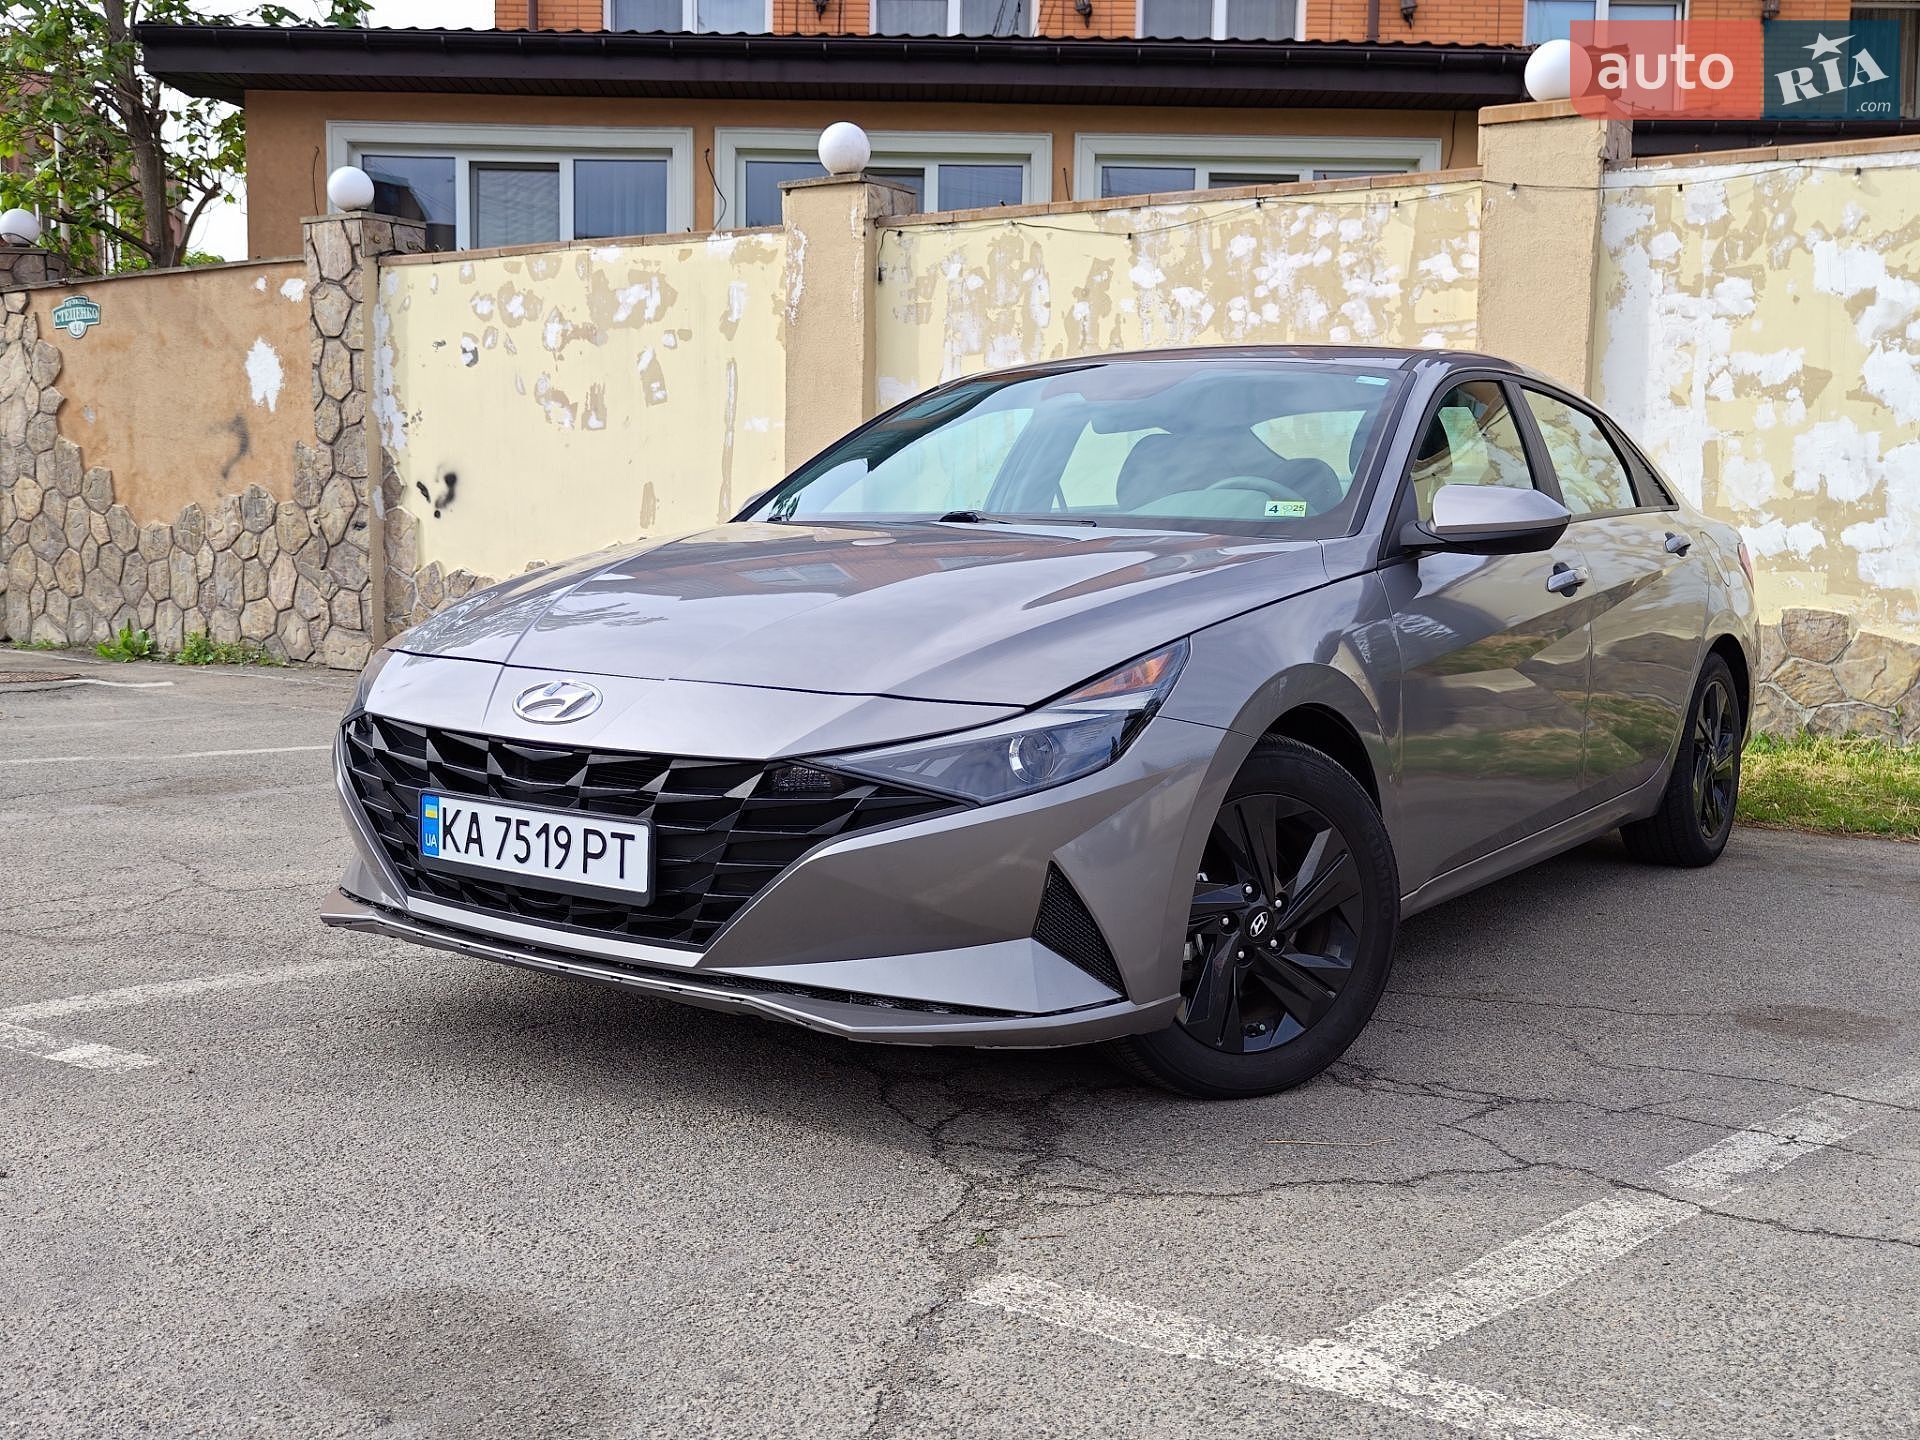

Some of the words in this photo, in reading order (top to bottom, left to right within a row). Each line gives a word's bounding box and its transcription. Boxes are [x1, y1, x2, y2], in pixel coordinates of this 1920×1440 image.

[55, 307, 97, 322] СТЕЦЕНКО
[1268, 504, 1279, 514] 4
[1293, 504, 1305, 512] 25
[425, 834, 438, 847] UA
[442, 807, 484, 857] KA
[494, 816, 572, 870] 7519
[582, 828, 636, 879] PT
